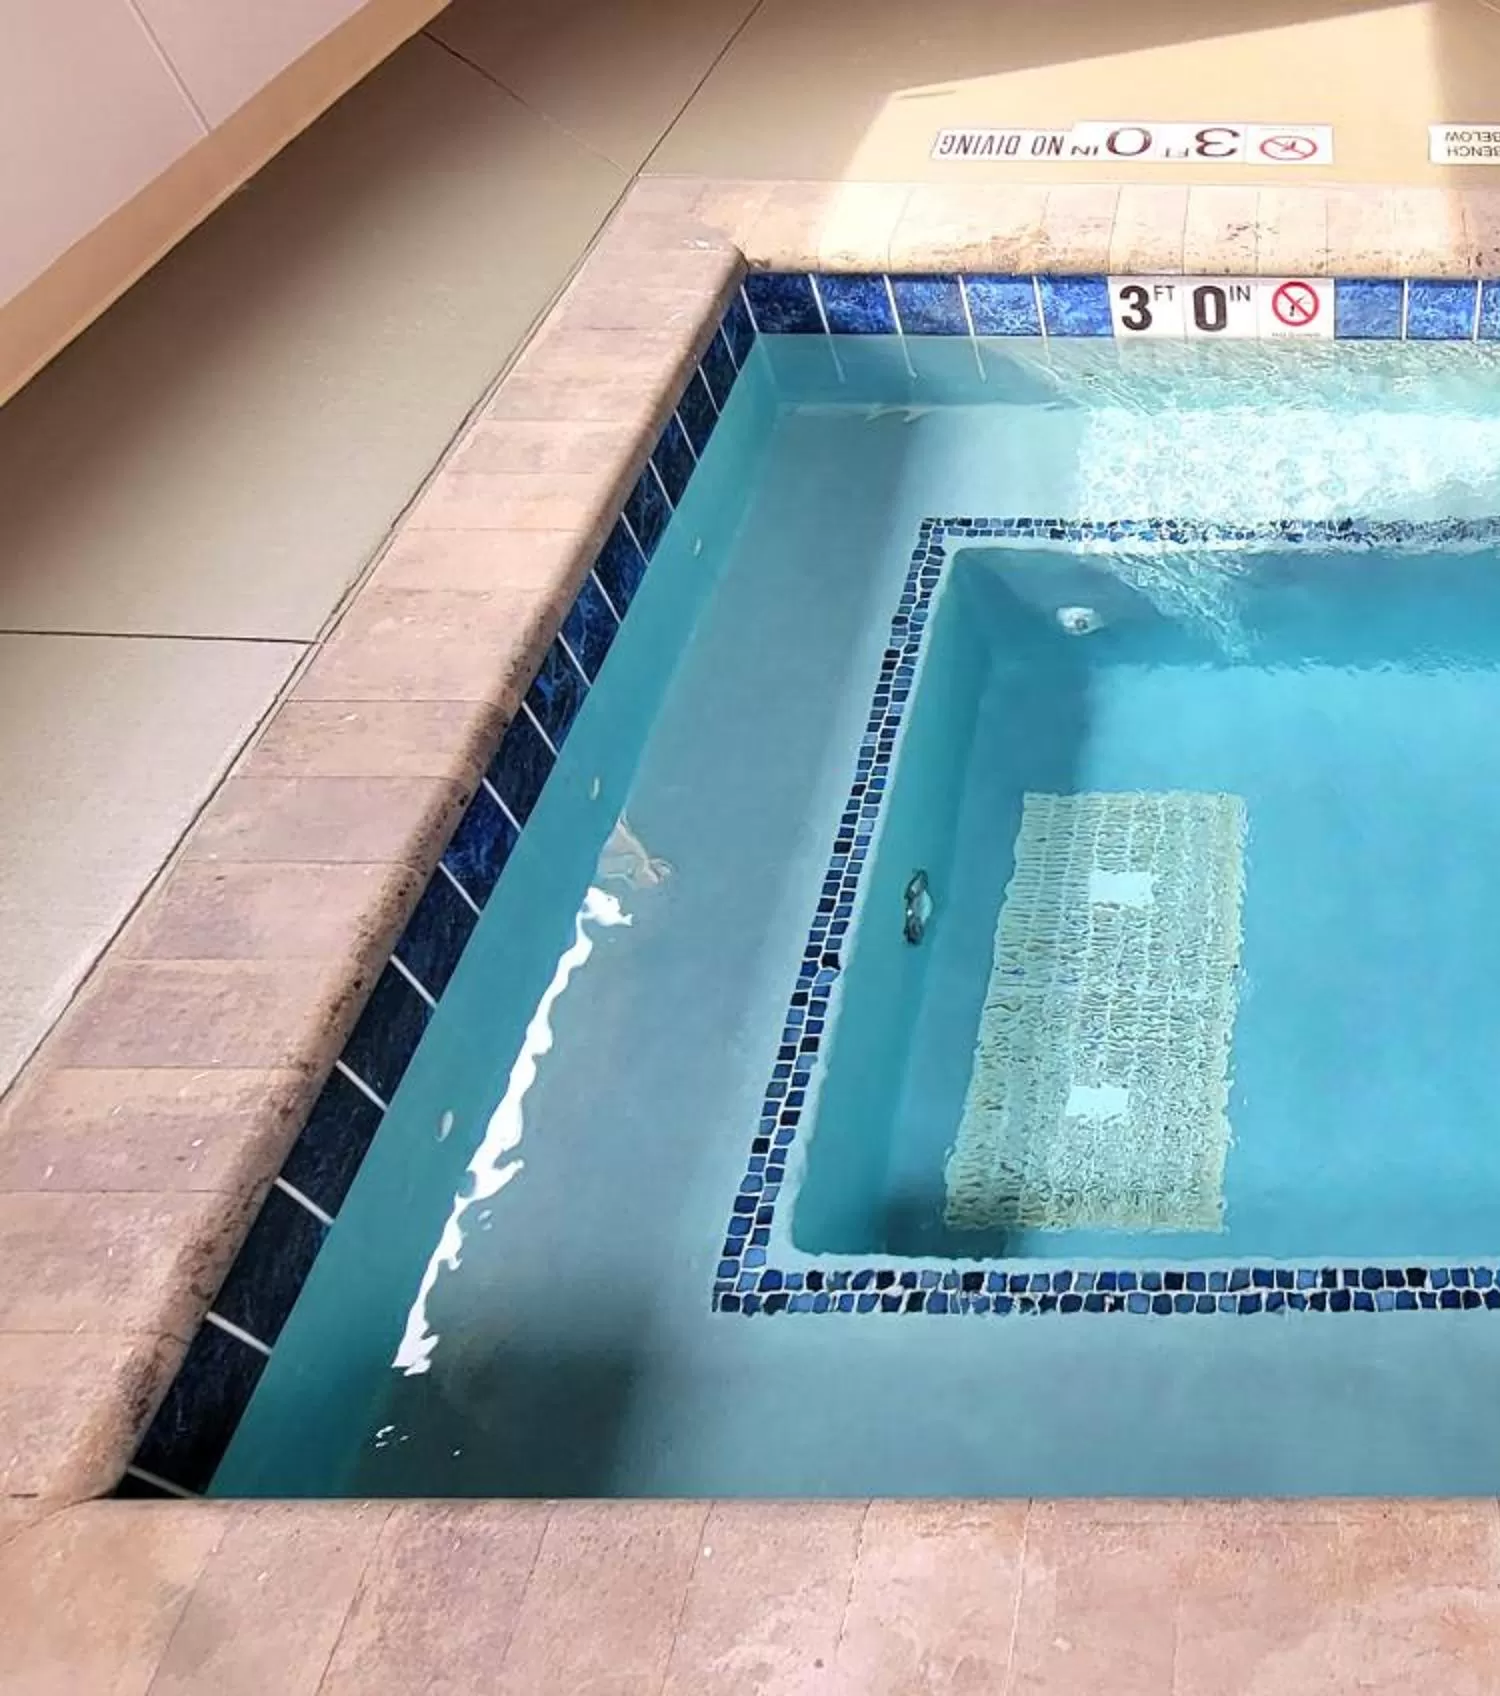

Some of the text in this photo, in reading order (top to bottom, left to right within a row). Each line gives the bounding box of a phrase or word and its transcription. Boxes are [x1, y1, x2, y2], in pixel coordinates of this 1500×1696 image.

[939, 134, 1022, 156] DIVING
[1030, 134, 1065, 157] NO
[1070, 145, 1100, 157] IN
[1105, 127, 1153, 157] 0
[1195, 127, 1241, 158] 3
[1119, 285, 1251, 332] 3 FT 0 IN
